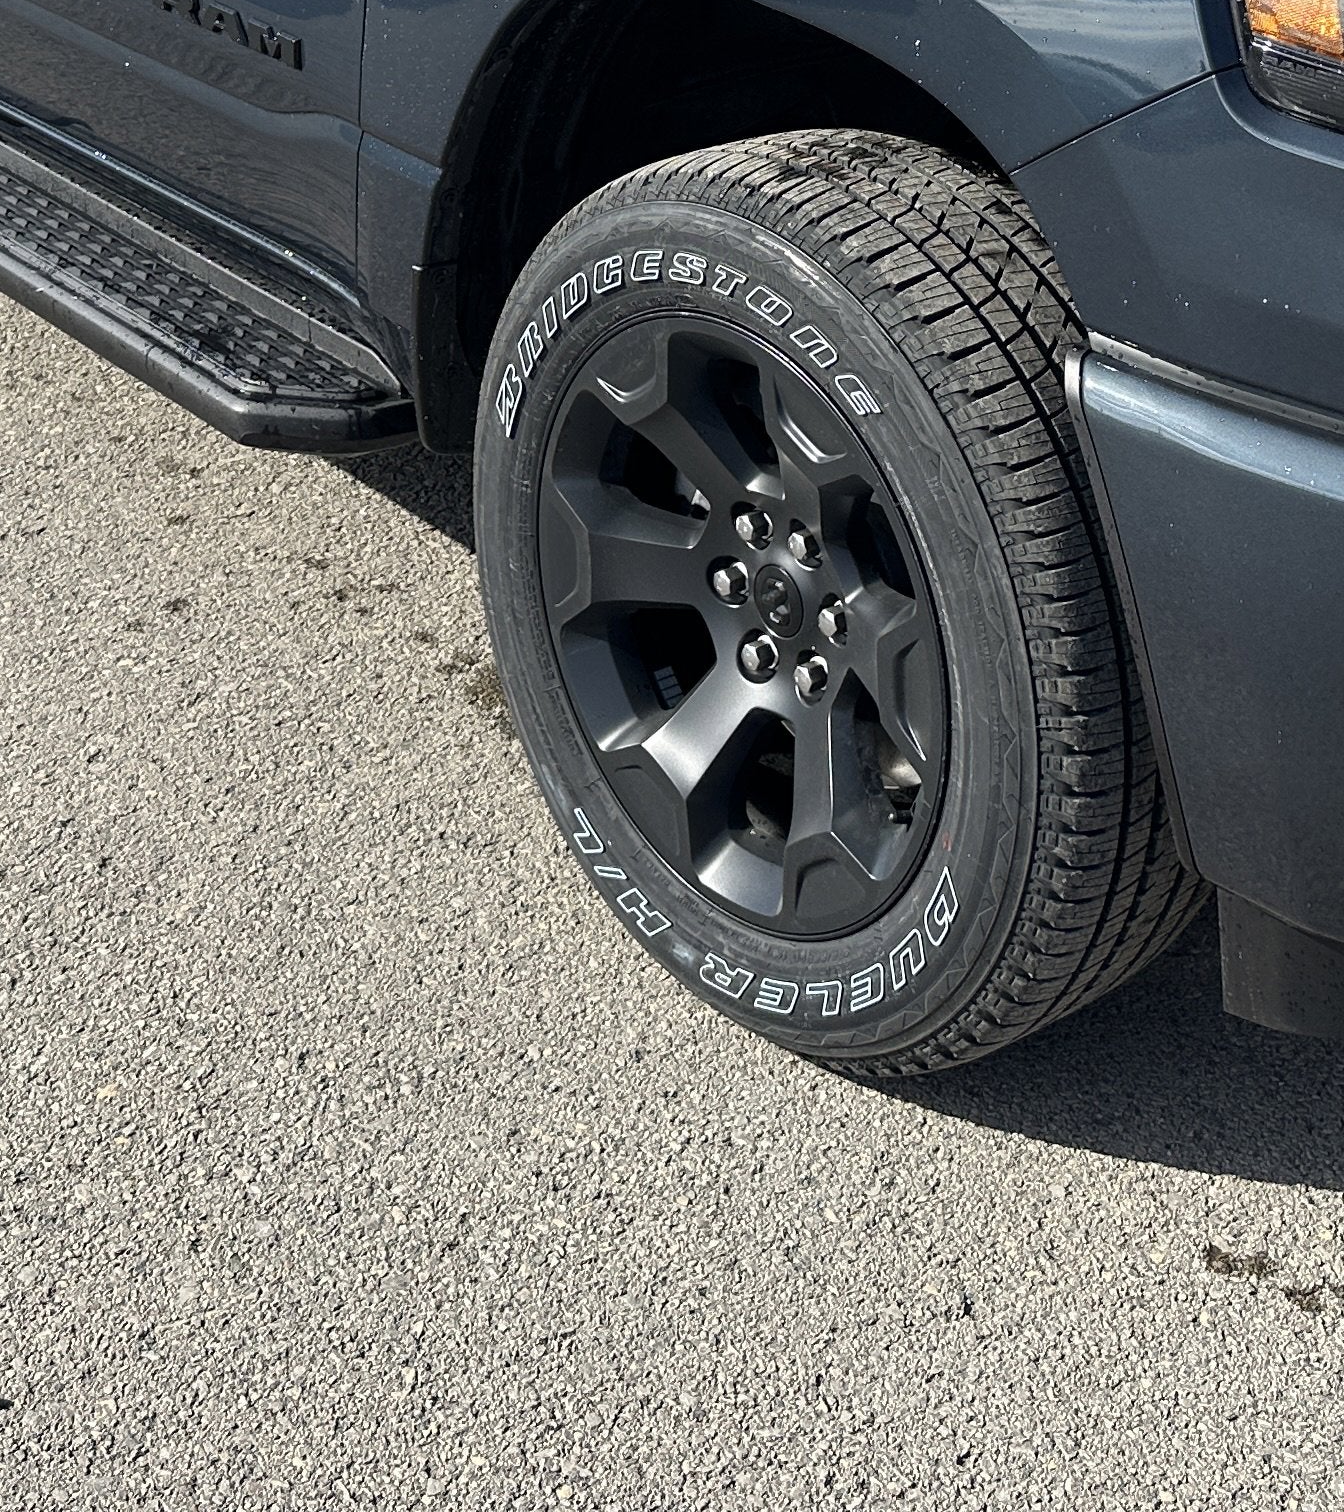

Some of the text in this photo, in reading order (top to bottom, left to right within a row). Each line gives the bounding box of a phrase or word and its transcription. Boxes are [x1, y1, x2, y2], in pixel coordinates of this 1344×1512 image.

[495, 249, 881, 438] BRIDGESTONE
[573, 807, 673, 938] H/L
[699, 866, 959, 1017] DUELER
